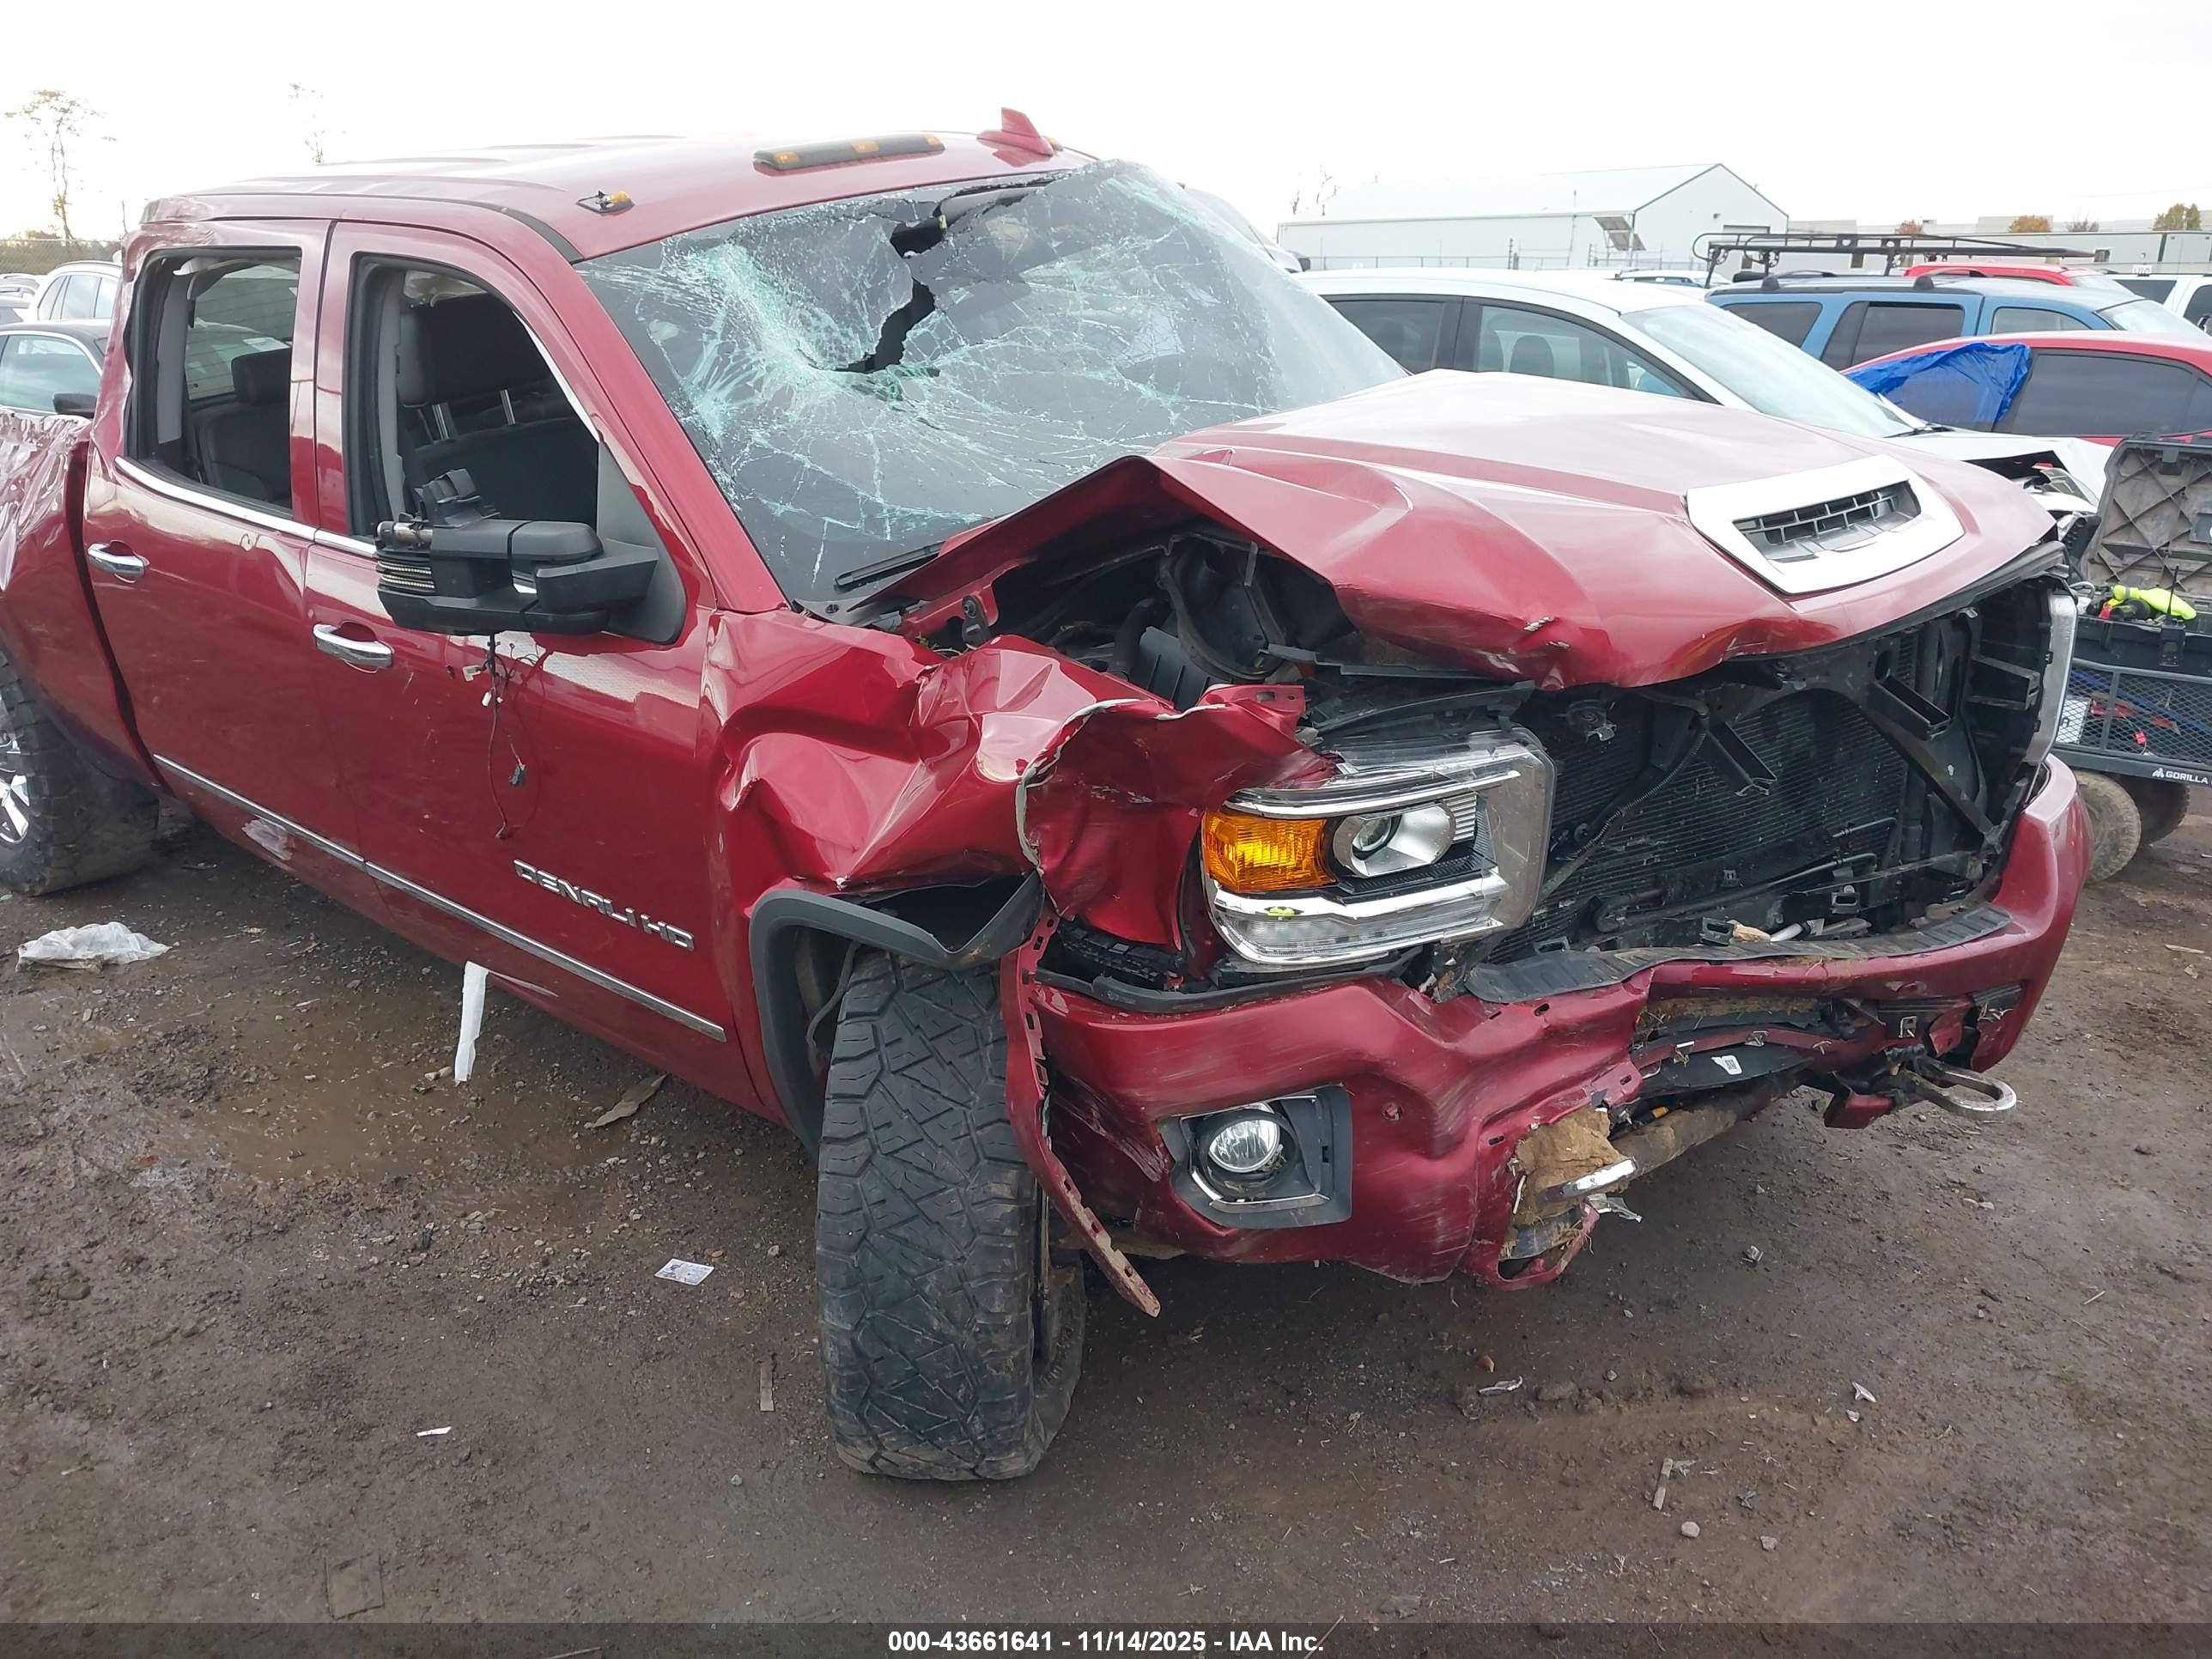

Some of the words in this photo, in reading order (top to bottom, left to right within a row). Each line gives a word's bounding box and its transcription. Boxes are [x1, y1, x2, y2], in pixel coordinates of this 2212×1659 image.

[2165, 770, 2209, 785] GORILLA
[514, 859, 637, 927] DENALI
[640, 914, 695, 951] HD
